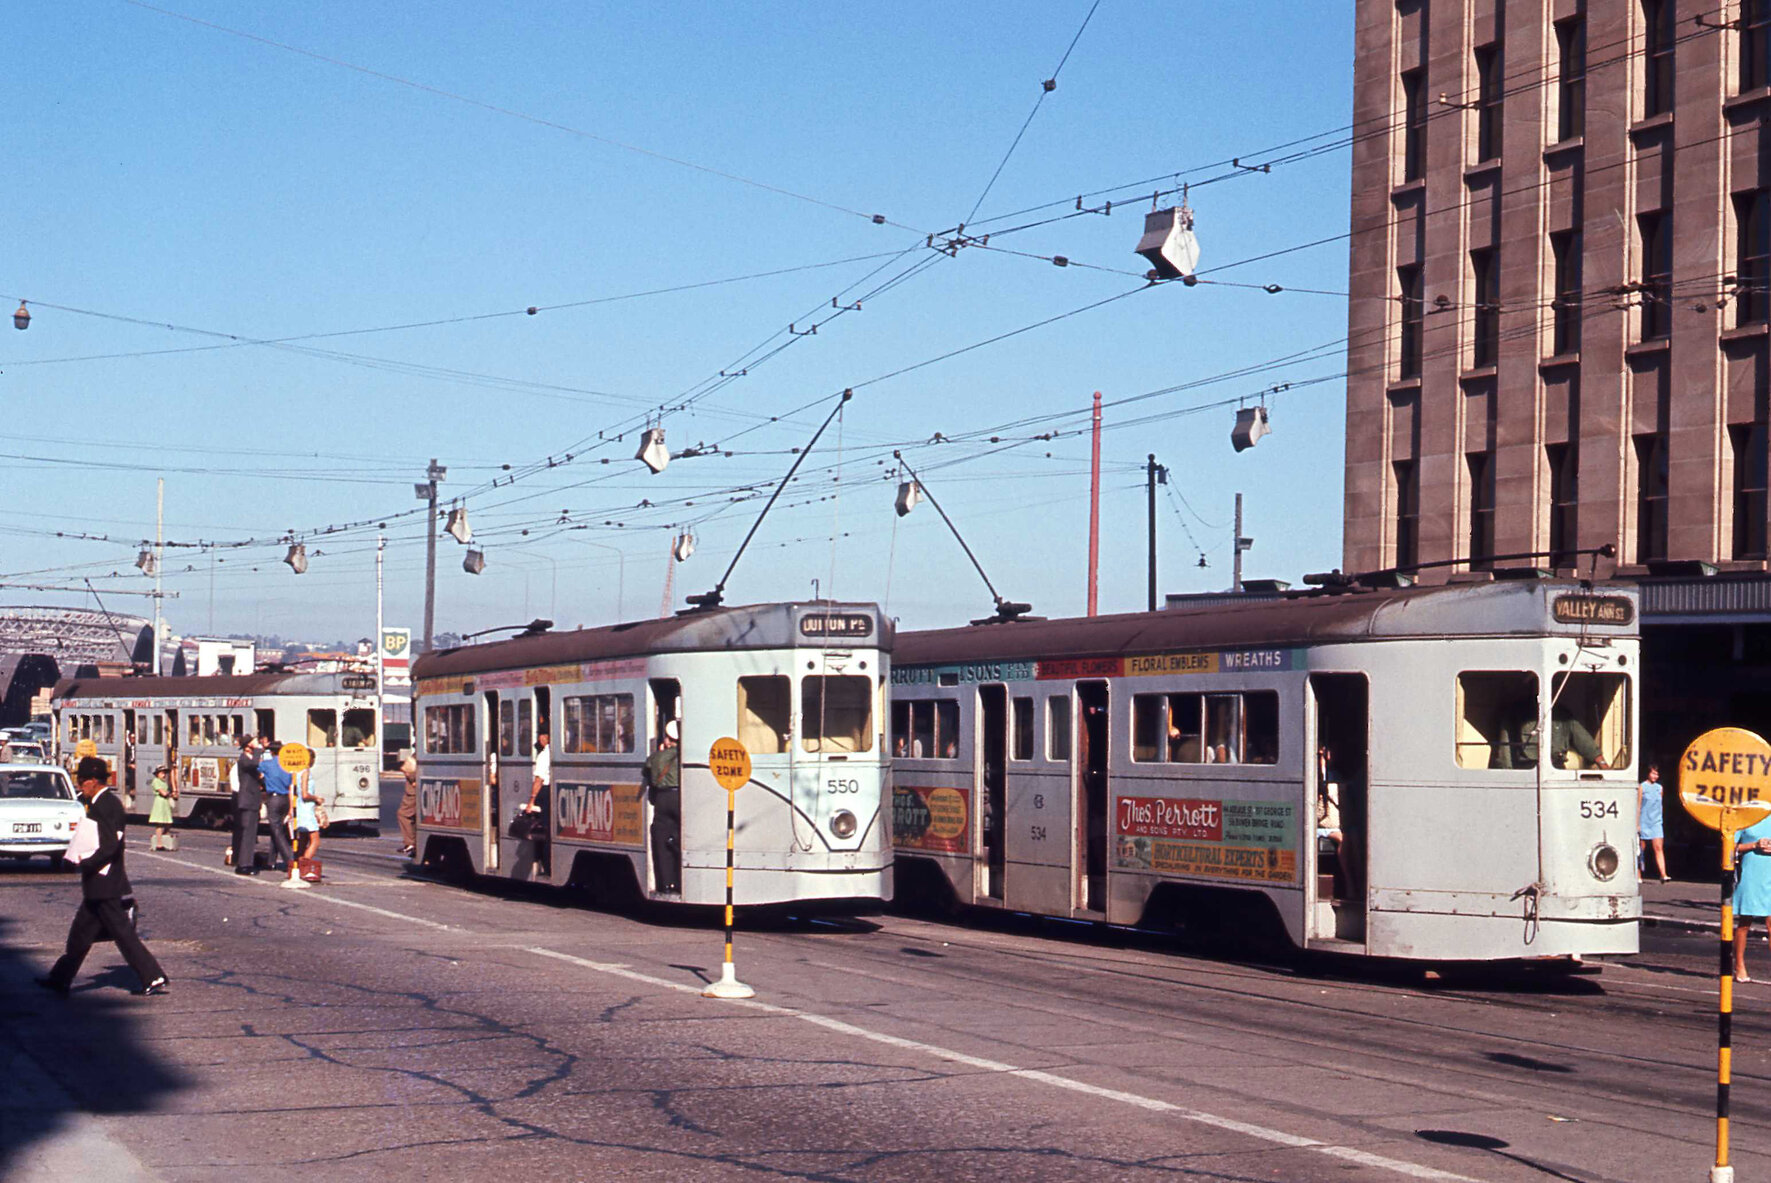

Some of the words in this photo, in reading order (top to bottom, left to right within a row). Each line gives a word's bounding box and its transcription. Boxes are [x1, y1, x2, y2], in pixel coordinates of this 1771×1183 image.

[1556, 602, 1597, 618] VALLEY
[1598, 605, 1615, 618] ANN
[385, 635, 406, 650] BP
[1132, 658, 1166, 672] FLORAL
[1170, 656, 1209, 670] EMBLEMS
[1225, 651, 1282, 667] WREATHS
[890, 669, 933, 683] RROTT
[967, 664, 1001, 682] SONS
[710, 748, 746, 761] SAFETY
[353, 764, 371, 773] 496
[717, 765, 743, 777] ZONE
[1686, 750, 1771, 776] SAFETY
[514, 780, 519, 793] 8
[827, 779, 859, 794] 550
[1696, 784, 1760, 805] ZONE
[421, 781, 460, 822] CINZANO
[558, 786, 613, 834] CINZANO
[1121, 799, 1155, 830] Thos.
[1155, 800, 1218, 828] Perrott
[1581, 801, 1619, 819] 534
[1031, 825, 1046, 841] 534
[1136, 826, 1148, 834] AND
[1150, 826, 1168, 835] SONS
[1172, 828, 1187, 836] PTY
[1193, 829, 1208, 837] LTD
[1154, 843, 1222, 865] HORTICULTURAL
[1223, 850, 1265, 869] EXPERTS
